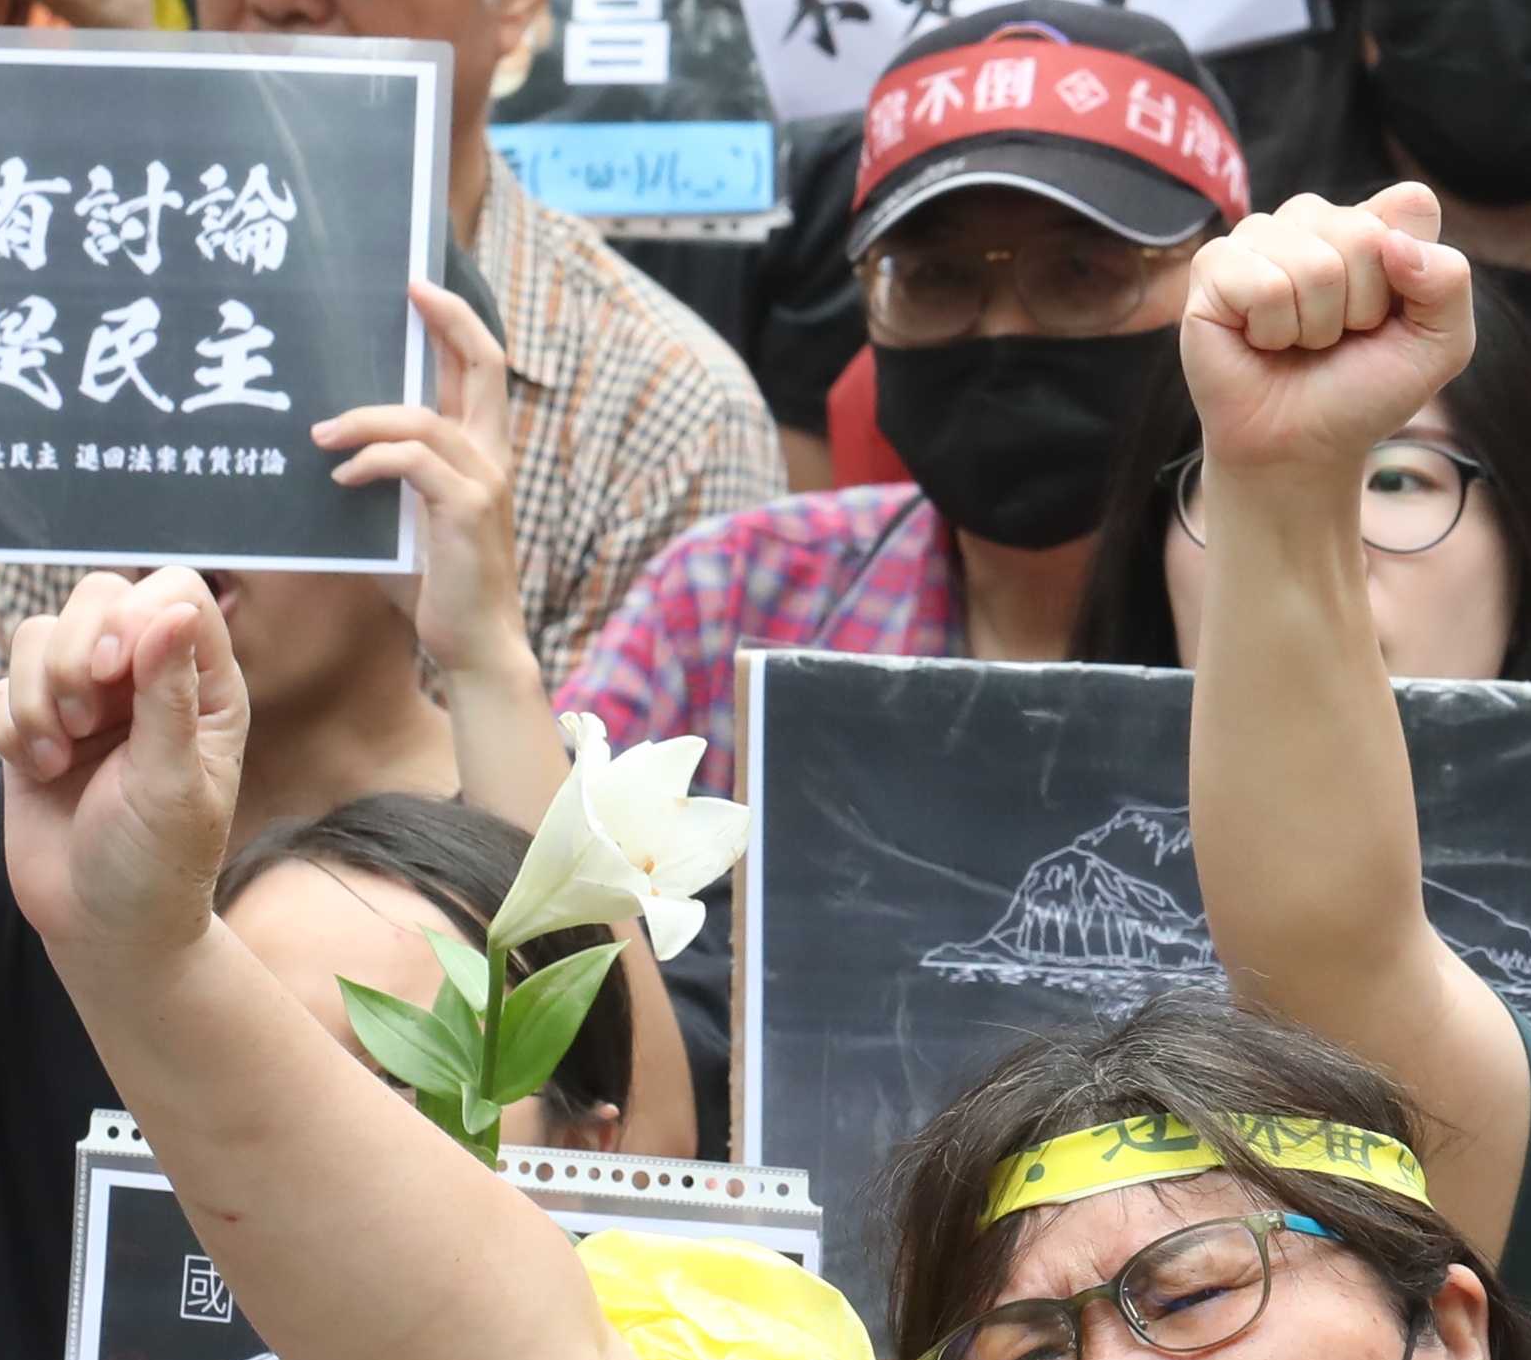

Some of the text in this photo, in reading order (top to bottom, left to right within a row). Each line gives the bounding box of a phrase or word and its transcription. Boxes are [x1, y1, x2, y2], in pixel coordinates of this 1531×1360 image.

[75, 441, 289, 478] 退回法案實質討論
